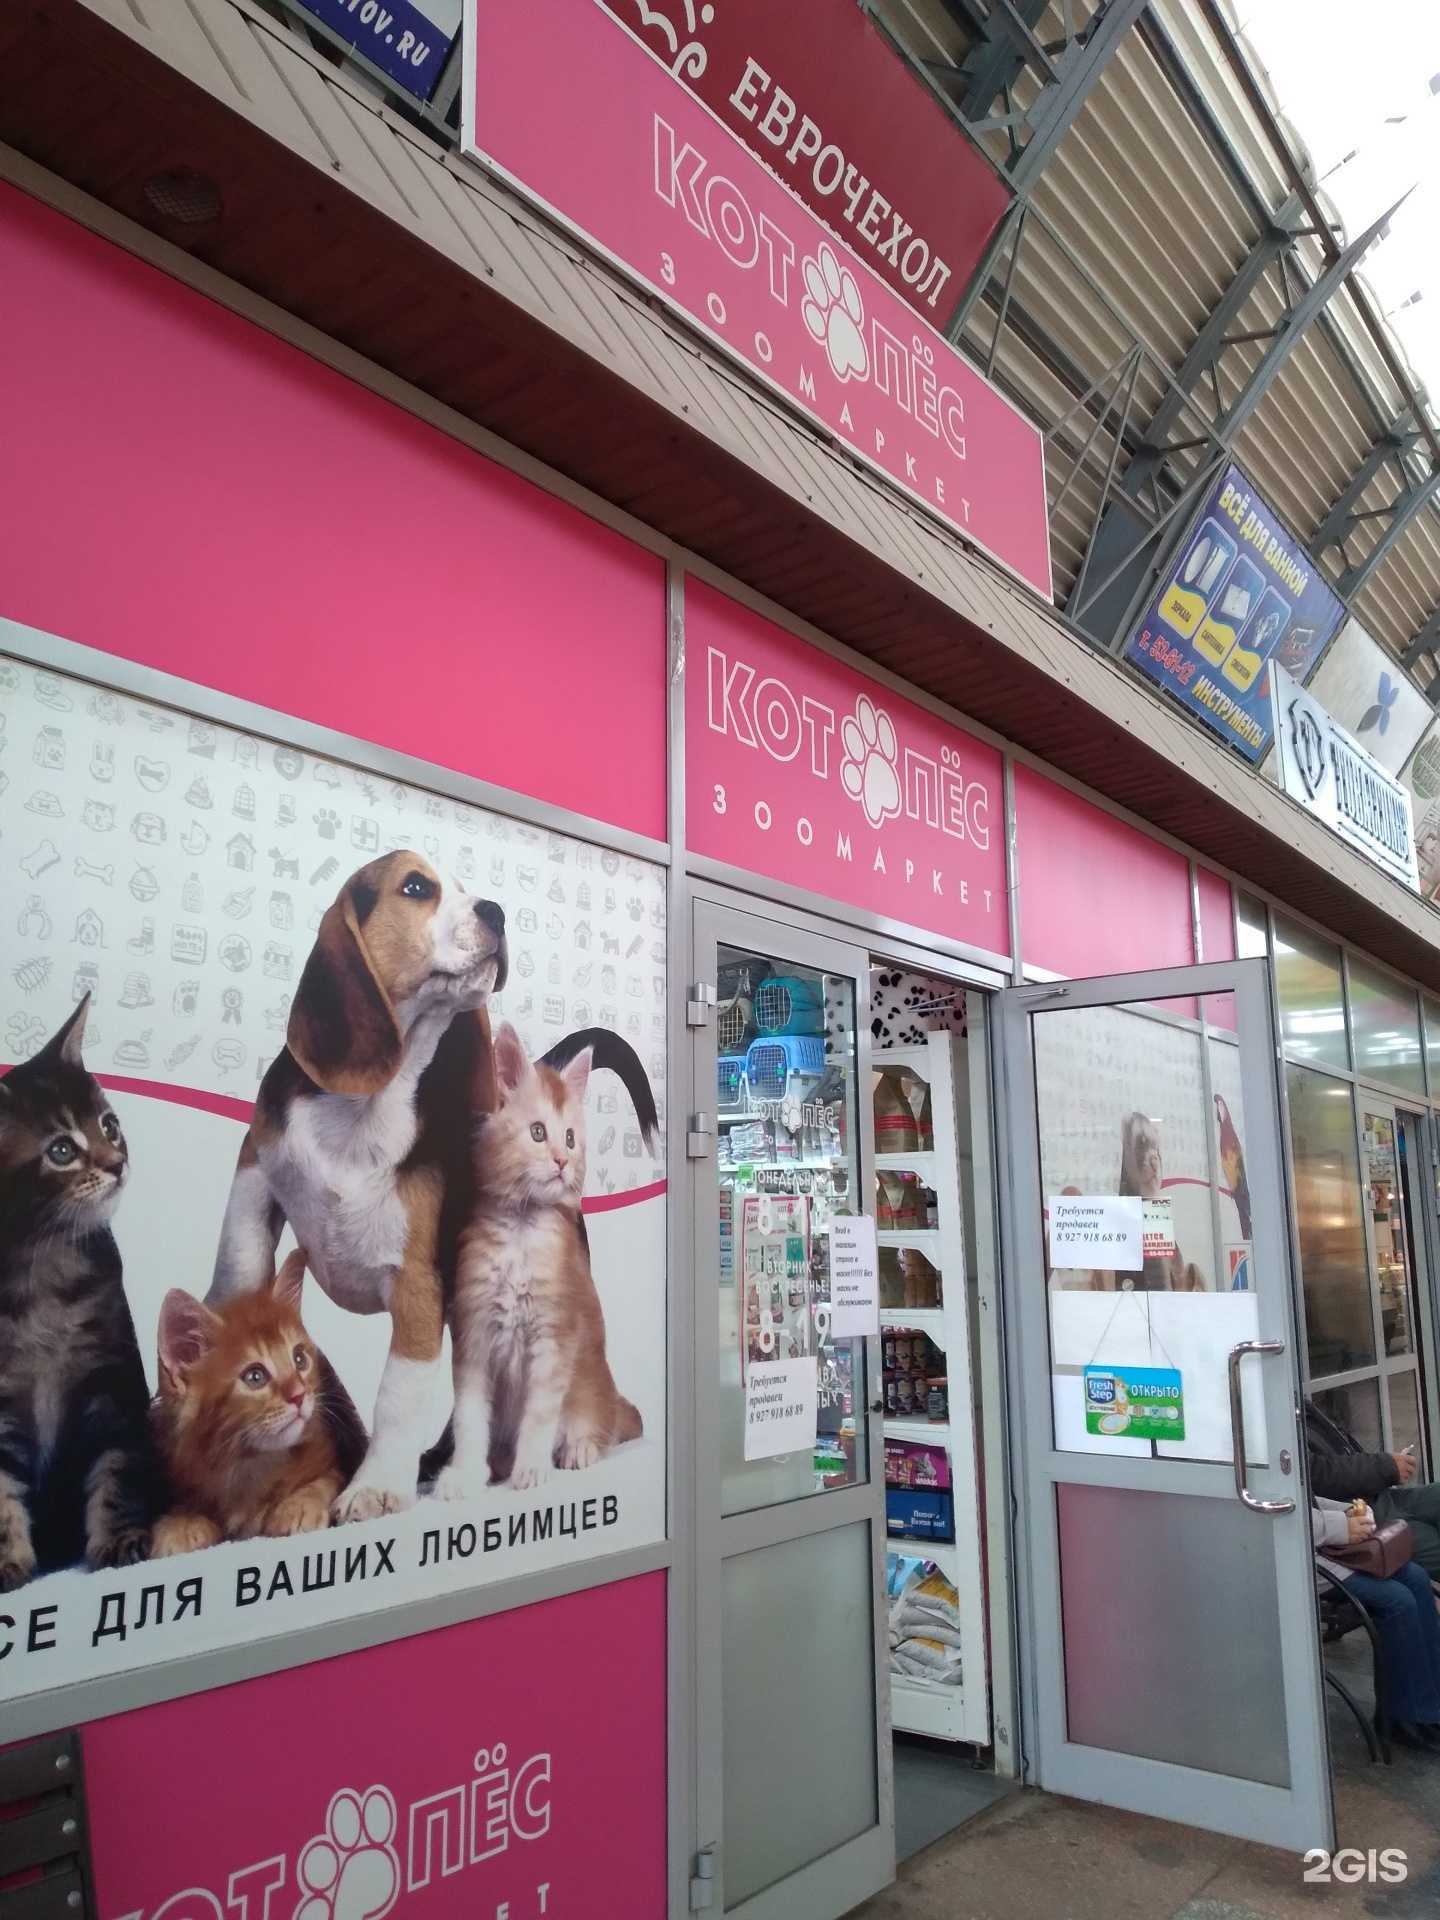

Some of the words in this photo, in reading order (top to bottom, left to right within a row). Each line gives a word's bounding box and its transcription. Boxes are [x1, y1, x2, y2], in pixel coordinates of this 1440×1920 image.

[337, 0, 430, 66] OV.RU
[729, 56, 951, 307] ЕВРОЧЕХОЛ
[654, 112, 795, 306] КОТ
[872, 317, 966, 460] ПЁС
[660, 251, 971, 522] ЗООМАРКЕТ
[1218, 482, 1250, 524] ВСЁ
[1239, 511, 1270, 552] ДЛЯ
[1263, 536, 1309, 598] ВАННОЙ
[707, 645, 835, 780] КОТ
[904, 745, 990, 850] ПЁС
[1191, 674, 1267, 749] ИНСТРУМЕНТЫ
[713, 783, 992, 913] ЗООМАРКЕТ
[1055, 1205, 1104, 1216] Требуется
[1055, 1220, 1099, 1231] продавец
[1056, 1232, 1063, 1242] 8
[1065, 1232, 1081, 1242] 927
[1083, 1232, 1099, 1242] 918
[1102, 1232, 1113, 1242] 68
[1115, 1232, 1127, 1242] 89
[1131, 1384, 1179, 1399] ОТКРЫТО
[91, 1576, 203, 1647] ДЛЯ
[235, 1538, 397, 1607] ВАШИХ
[418, 1494, 619, 1568] ЛЮБИМЦЕВ
[407, 1743, 551, 1893] ПЁС
